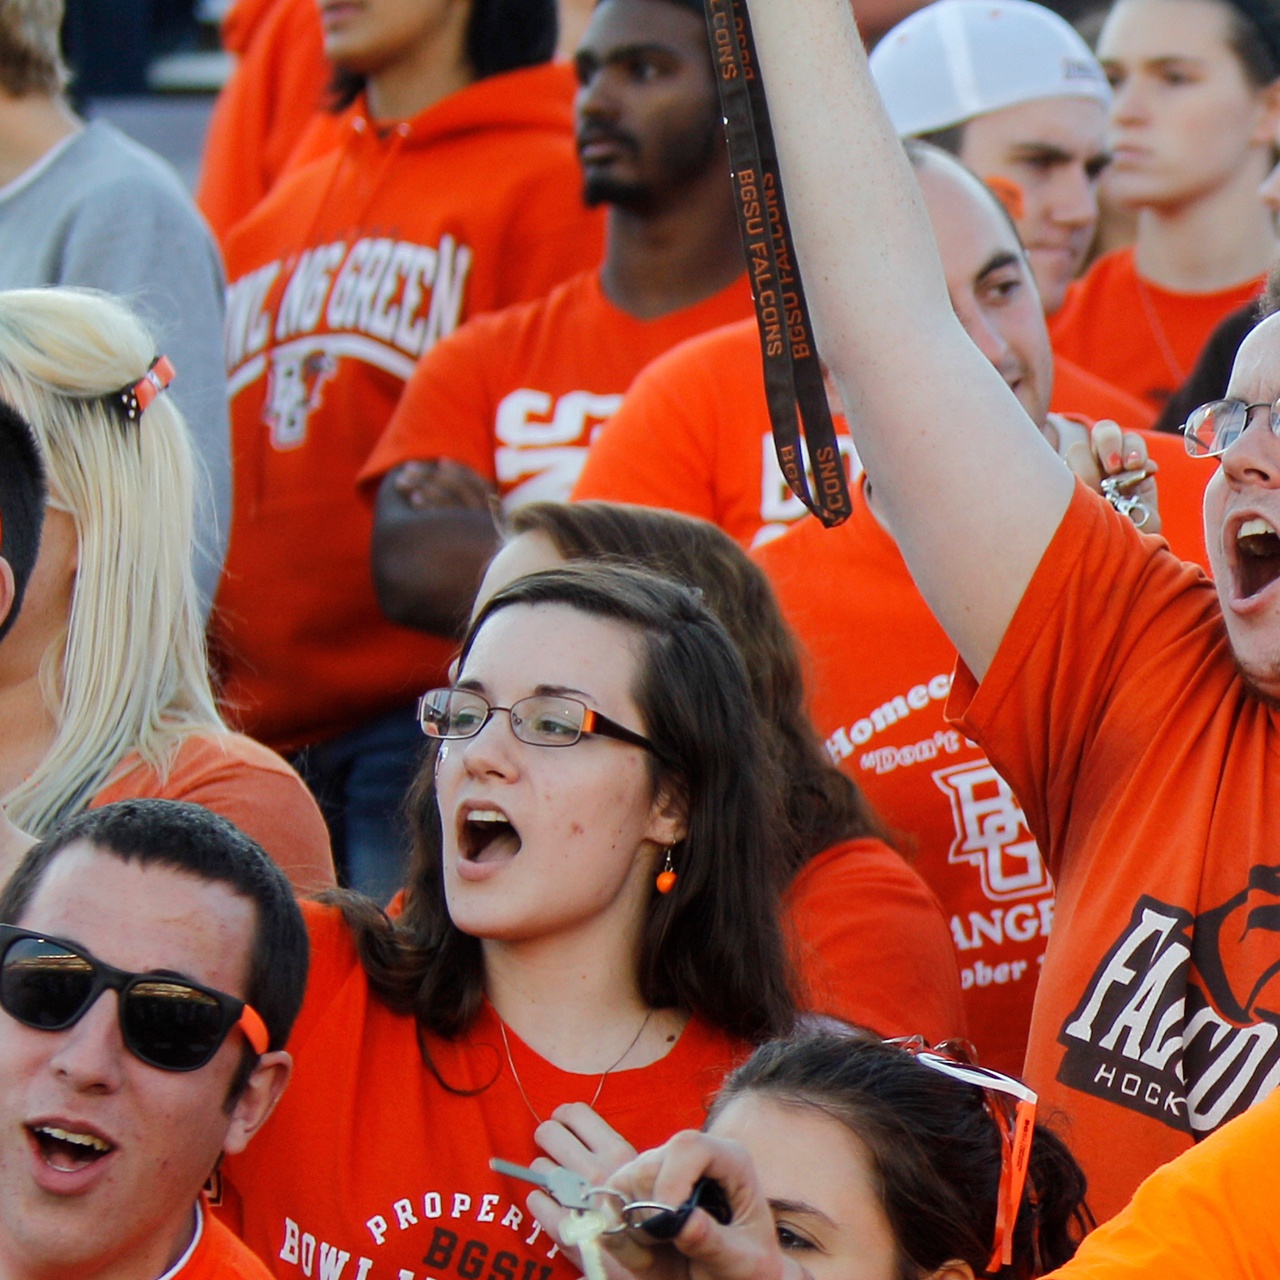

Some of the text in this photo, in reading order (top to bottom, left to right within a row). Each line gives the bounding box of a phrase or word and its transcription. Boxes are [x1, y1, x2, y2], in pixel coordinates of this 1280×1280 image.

[326, 234, 472, 358] GREEN
[738, 169, 783, 357] BGSU FALCONS
[784, 290, 811, 360] BGSU
[816, 446, 846, 512] CONS
